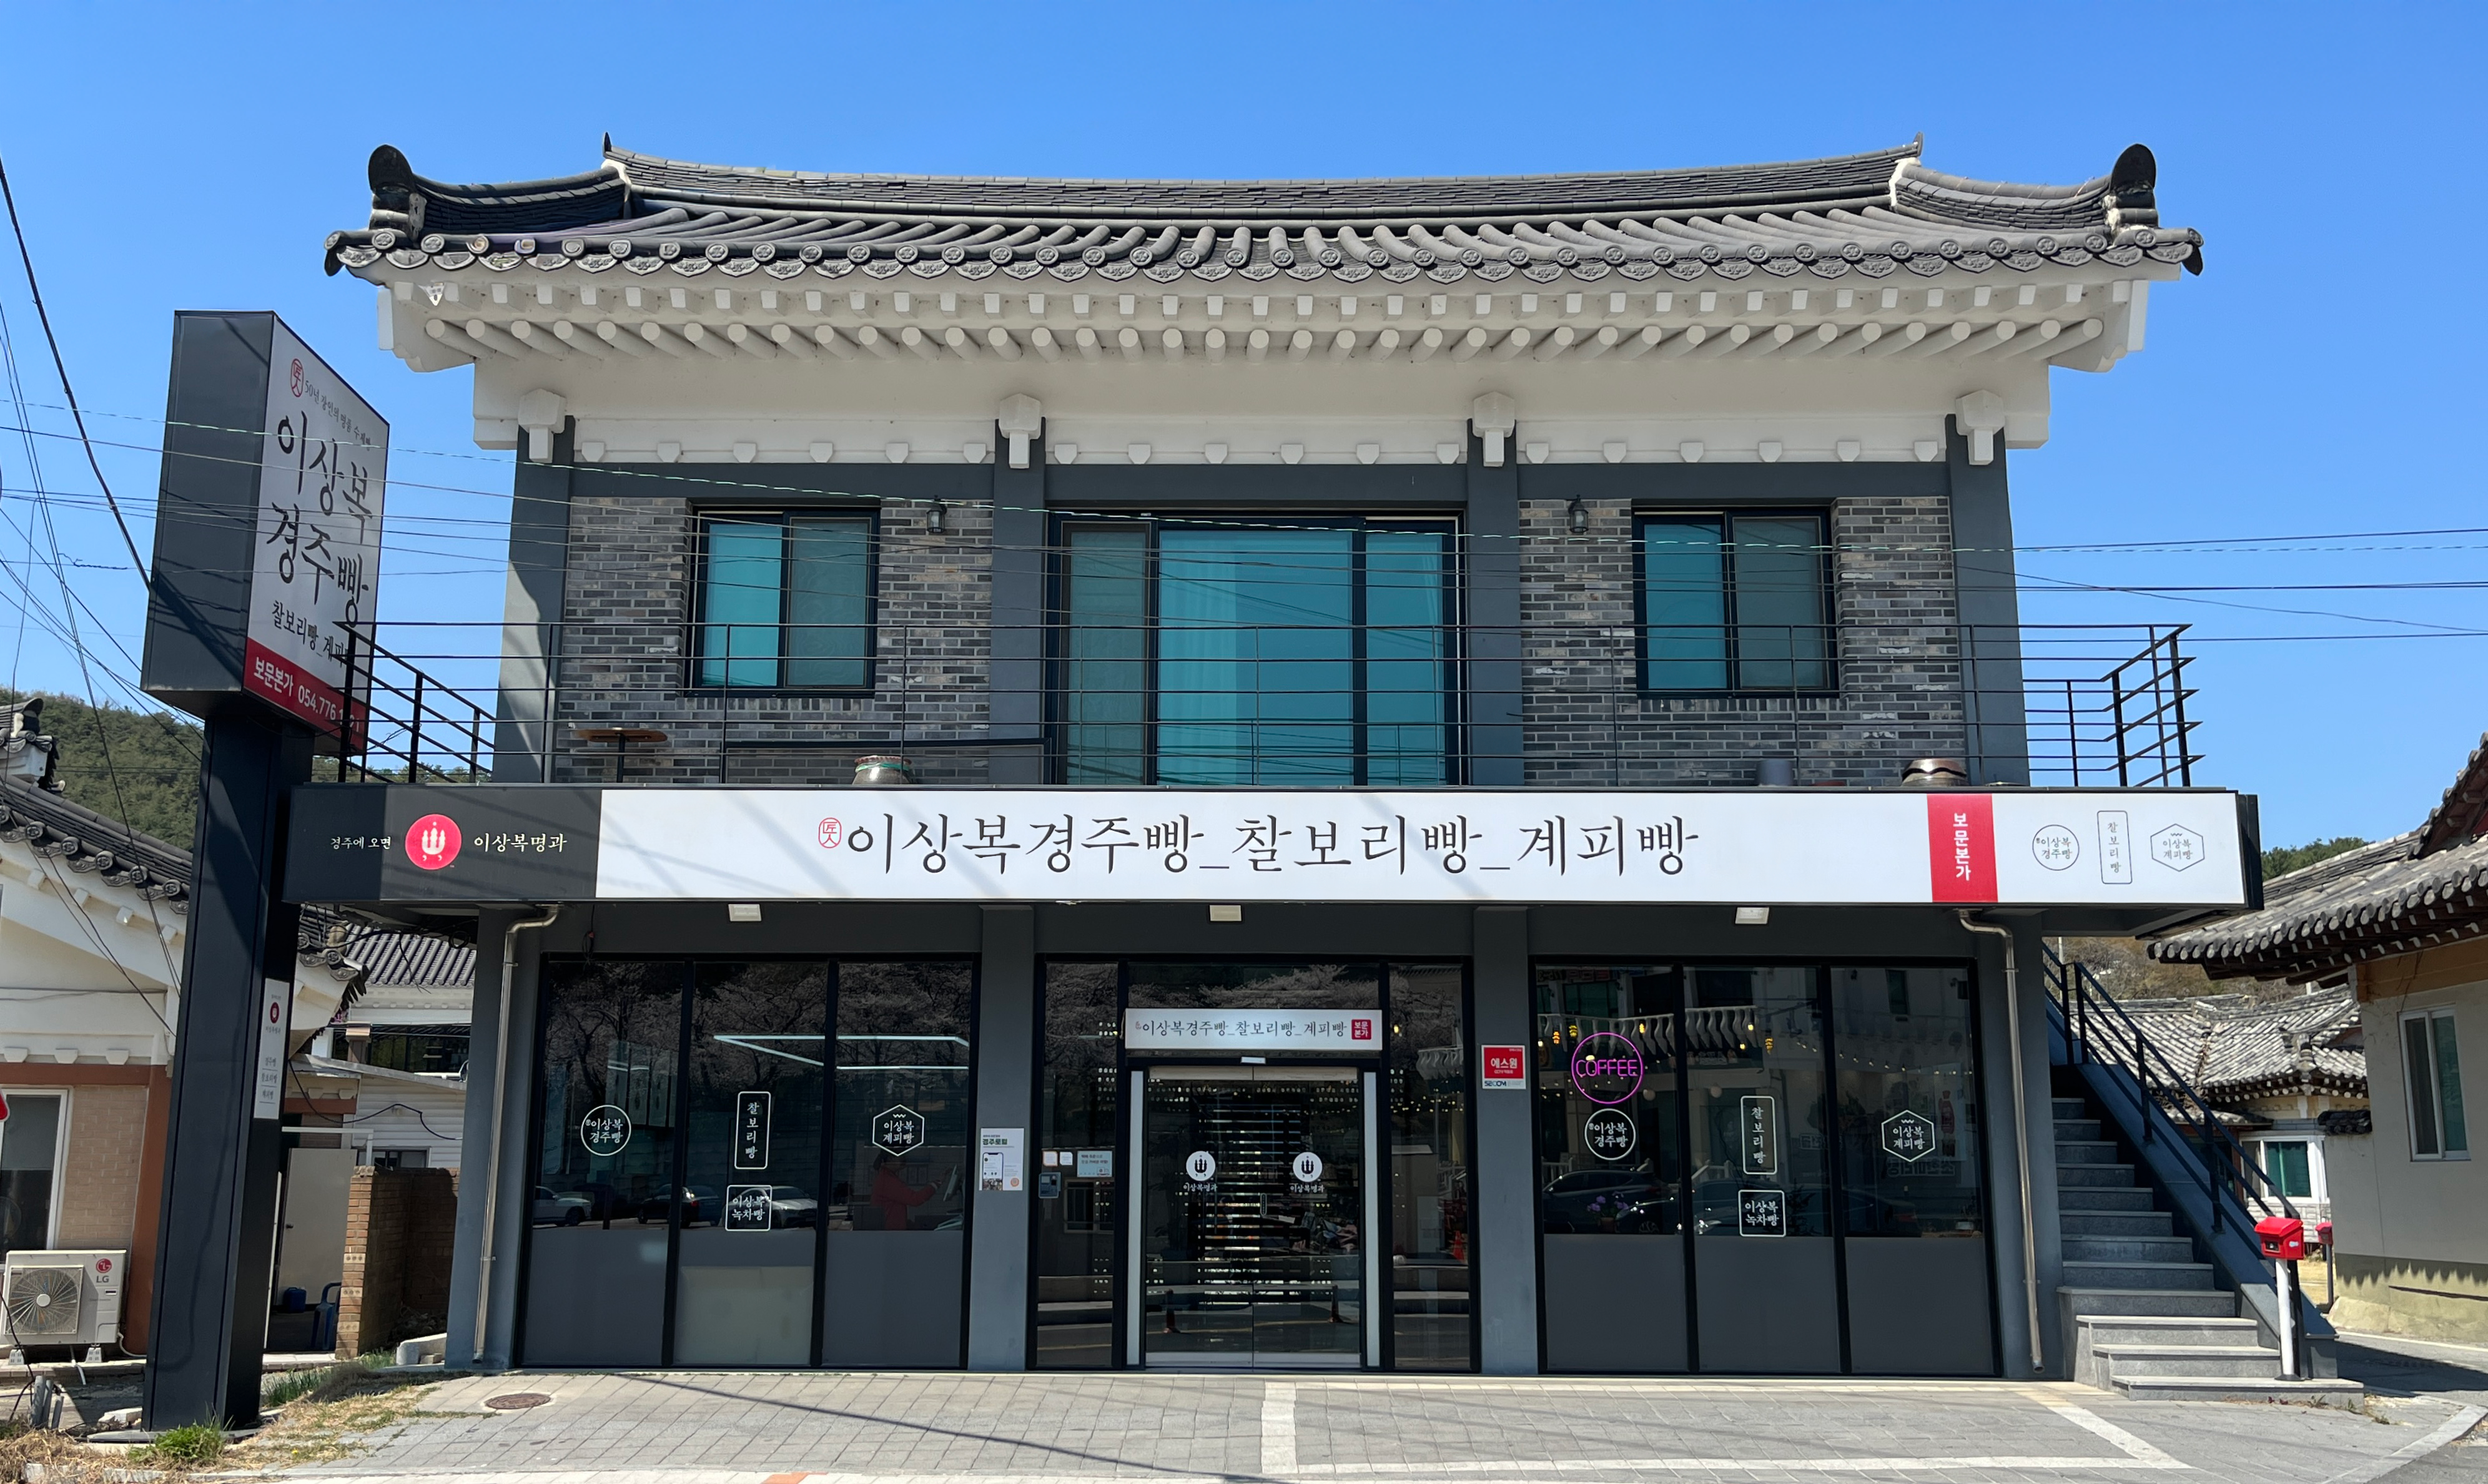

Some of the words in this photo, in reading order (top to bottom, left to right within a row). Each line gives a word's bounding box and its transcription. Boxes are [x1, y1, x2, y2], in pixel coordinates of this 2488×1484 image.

[305, 380, 320, 405] 50년
[277, 410, 373, 545] 이상복
[266, 501, 369, 628] 경주빵
[253, 656, 294, 697] 보문본가
[330, 836, 365, 850] 경주에
[367, 835, 391, 850] 오면
[473, 832, 568, 853] 이상복명과
[1953, 812, 1971, 881] 보문본가
[2041, 837, 2071, 848] 이상복
[2163, 838, 2191, 850] 이상복
[2041, 848, 2073, 860] 경주빵
[2163, 850, 2193, 860] 계피빵
[1354, 1021, 1368, 1029] 보문
[1354, 1029, 1369, 1038] 본가
[1490, 1058, 1518, 1069] 에스원
[1576, 1059, 1639, 1078] COFFEE
[591, 1118, 623, 1131] 이상복
[745, 1102, 759, 1159] 찰보리빵
[884, 1120, 914, 1132] 이상복
[1594, 1122, 1627, 1135] 이상복
[590, 1131, 623, 1144] 경주빵
[882, 1132, 914, 1144] 계피빵
[1751, 1106, 1766, 1164] 찰보리빵
[1892, 1126, 1925, 1138] 이상복
[1594, 1135, 1629, 1147] 경주빵
[1893, 1138, 1926, 1150] 계피빵
[1183, 1182, 1218, 1192] 이상복명과
[1290, 1184, 1325, 1193] 이상복명과
[732, 1195, 766, 1208] 이상복
[1744, 1200, 1779, 1213] 이상복
[731, 1208, 766, 1221] 녹차빵
[1745, 1213, 1780, 1227] 녹차빵
